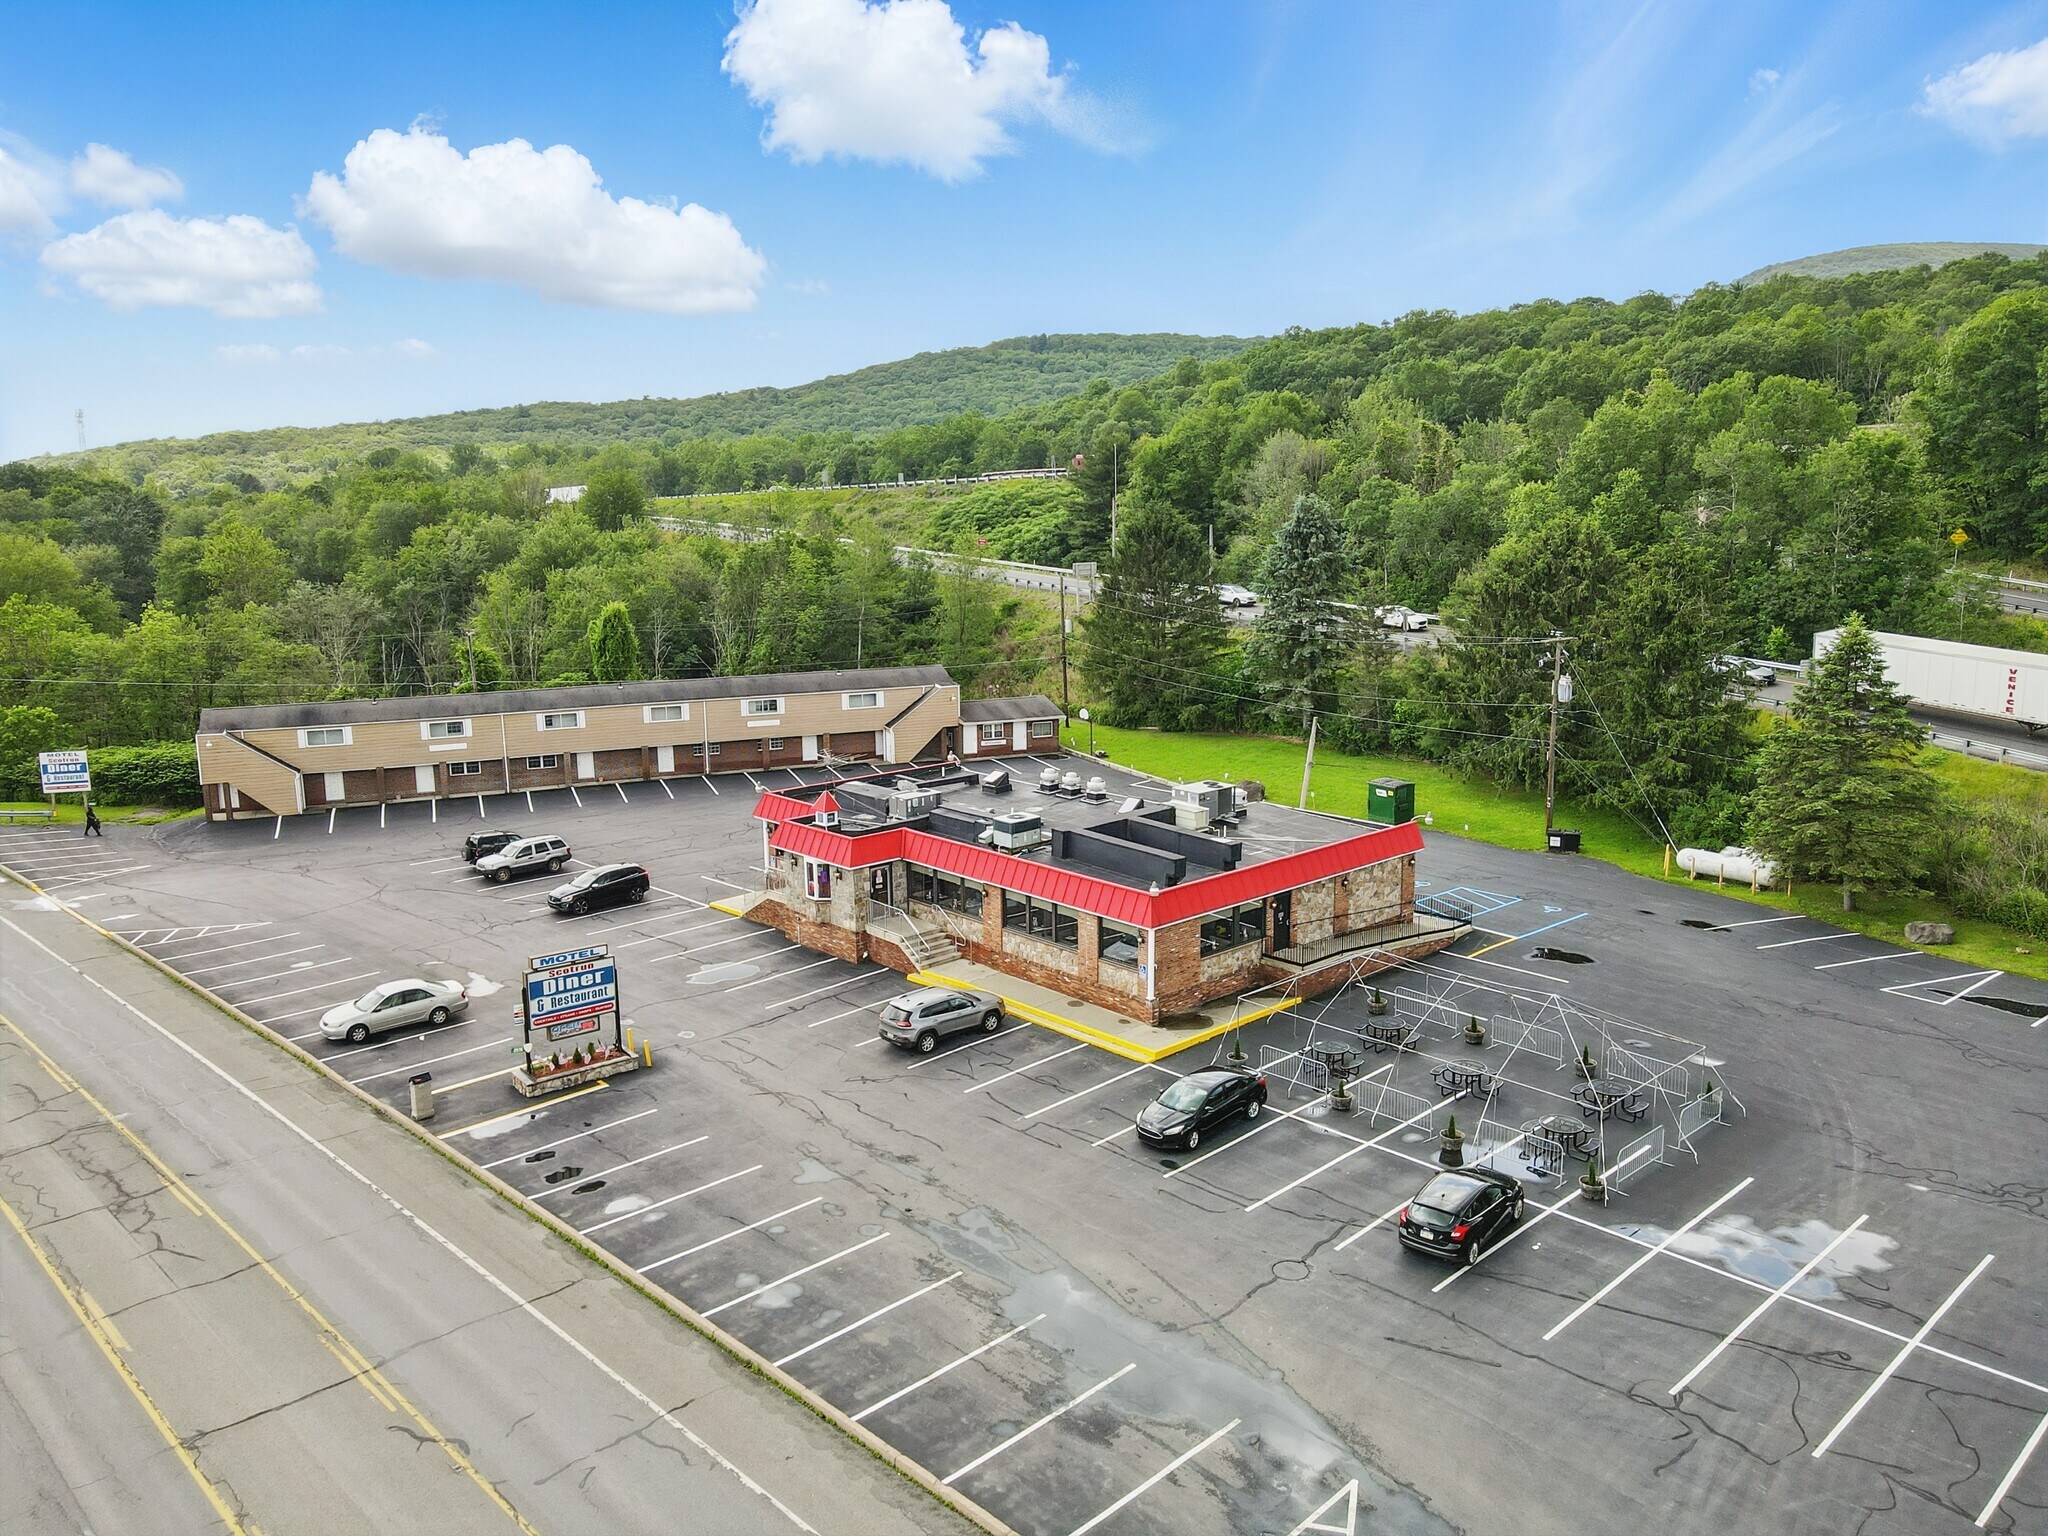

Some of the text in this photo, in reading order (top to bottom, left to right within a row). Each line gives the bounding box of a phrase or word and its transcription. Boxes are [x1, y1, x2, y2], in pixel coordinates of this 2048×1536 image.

[2006, 668, 2018, 713] VENICE
[47, 764, 82, 773] Diner
[540, 949, 600, 966] MOTEL
[549, 963, 594, 978] Scotrun
[543, 970, 606, 995] Diner
[537, 986, 608, 1012] & Restaurant
